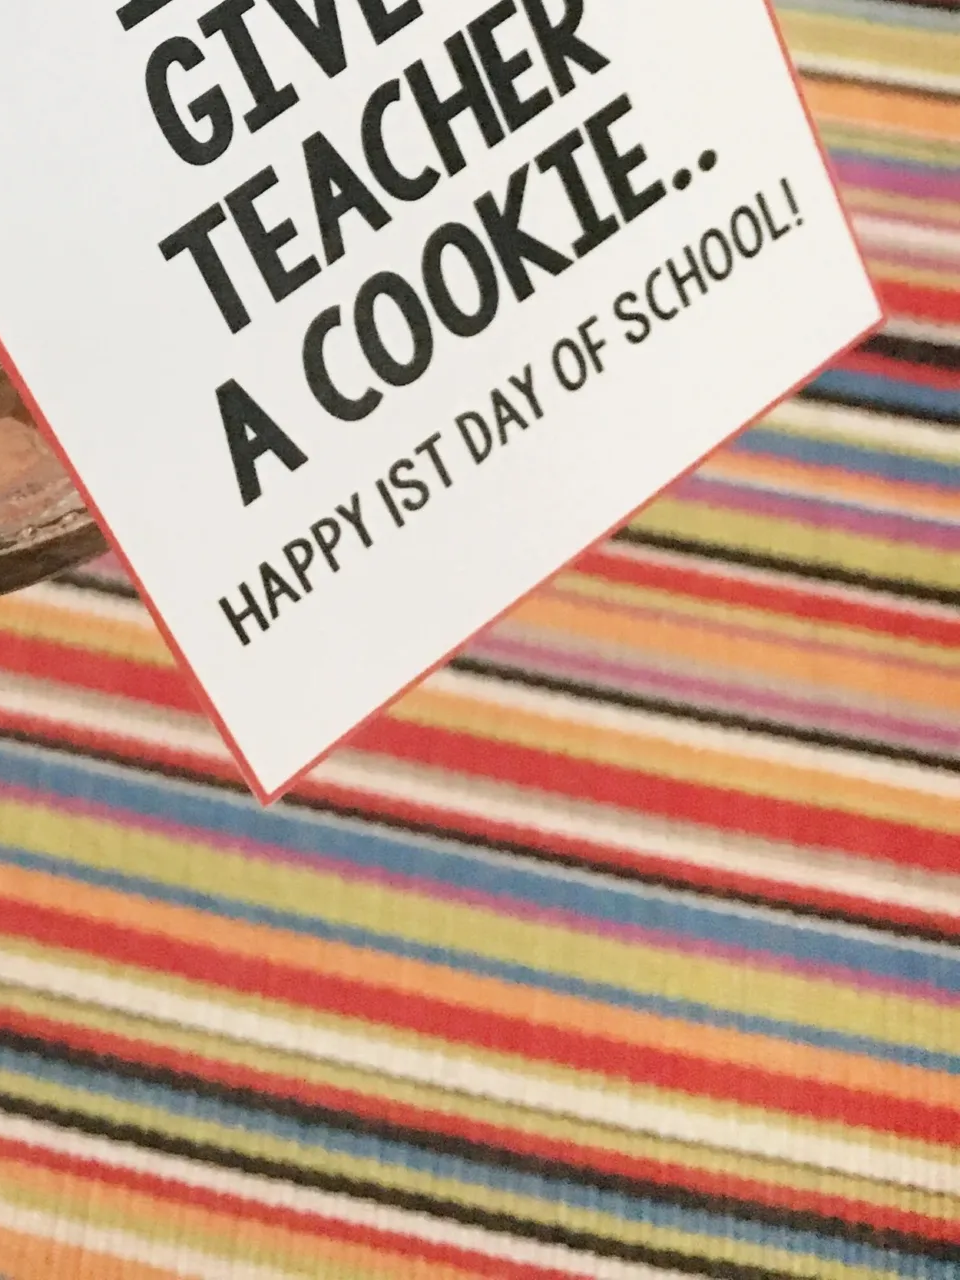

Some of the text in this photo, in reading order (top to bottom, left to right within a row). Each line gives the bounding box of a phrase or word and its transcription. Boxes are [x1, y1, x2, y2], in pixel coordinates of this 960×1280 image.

[214, 377, 309, 507] A
[217, 492, 374, 647] HAPPY
[454, 363, 545, 466] DAY
[551, 314, 607, 393] OF
[611, 176, 806, 346] SCHOOL!
